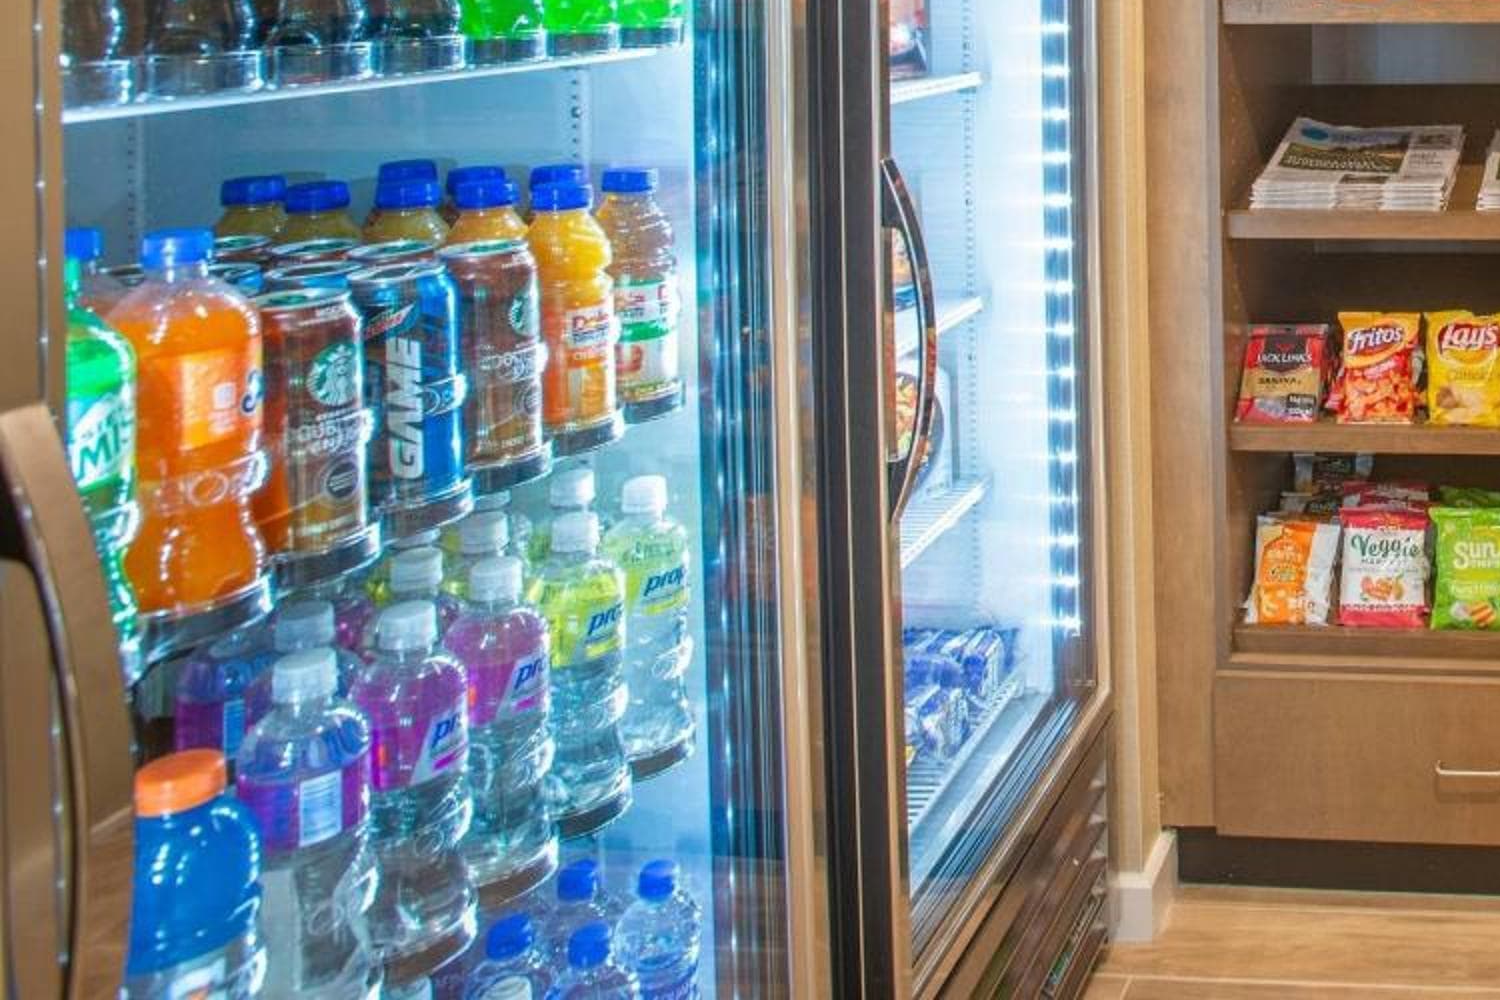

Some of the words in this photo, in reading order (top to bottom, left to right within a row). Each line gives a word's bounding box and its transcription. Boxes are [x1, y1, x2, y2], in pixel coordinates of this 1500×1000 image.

[1348, 327, 1404, 355] Fritos
[1441, 322, 1500, 349] Lay's
[386, 337, 424, 479] GAME
[1351, 533, 1421, 559] Veggie
[1453, 541, 1500, 569] Sun
